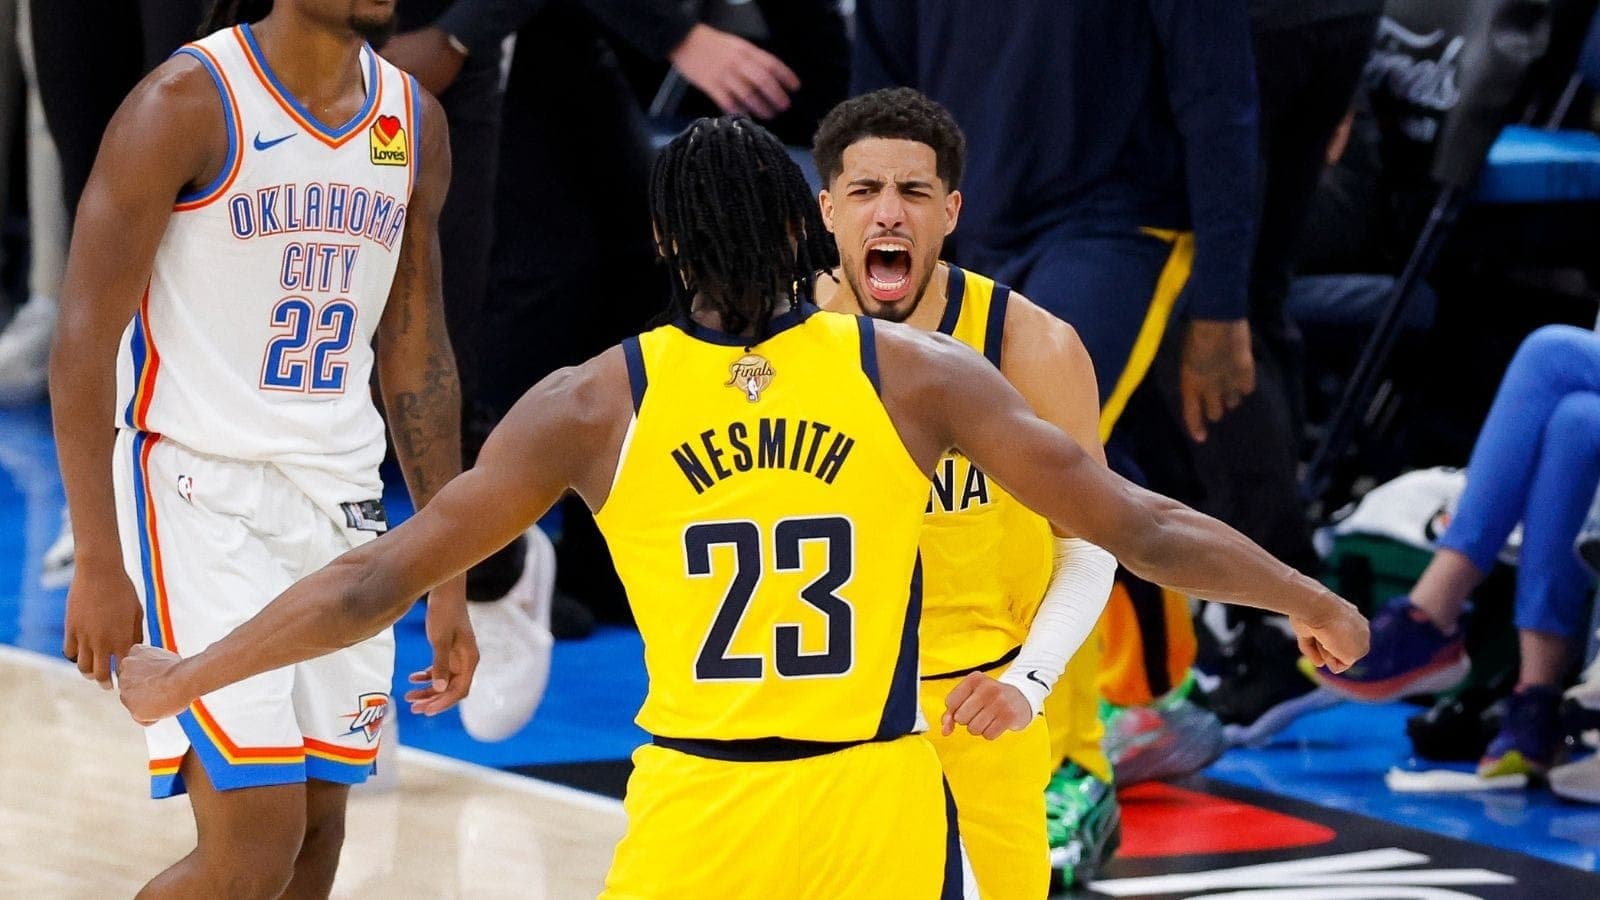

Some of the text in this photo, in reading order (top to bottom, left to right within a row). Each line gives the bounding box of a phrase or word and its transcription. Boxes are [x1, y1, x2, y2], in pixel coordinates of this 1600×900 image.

[373, 146, 406, 162] Love's
[228, 182, 407, 252] OKLAHOMA
[279, 242, 360, 293] CITY
[259, 295, 359, 394] 22
[724, 361, 774, 386] Finals
[671, 418, 856, 495] NESMITH
[683, 514, 854, 682] 23
